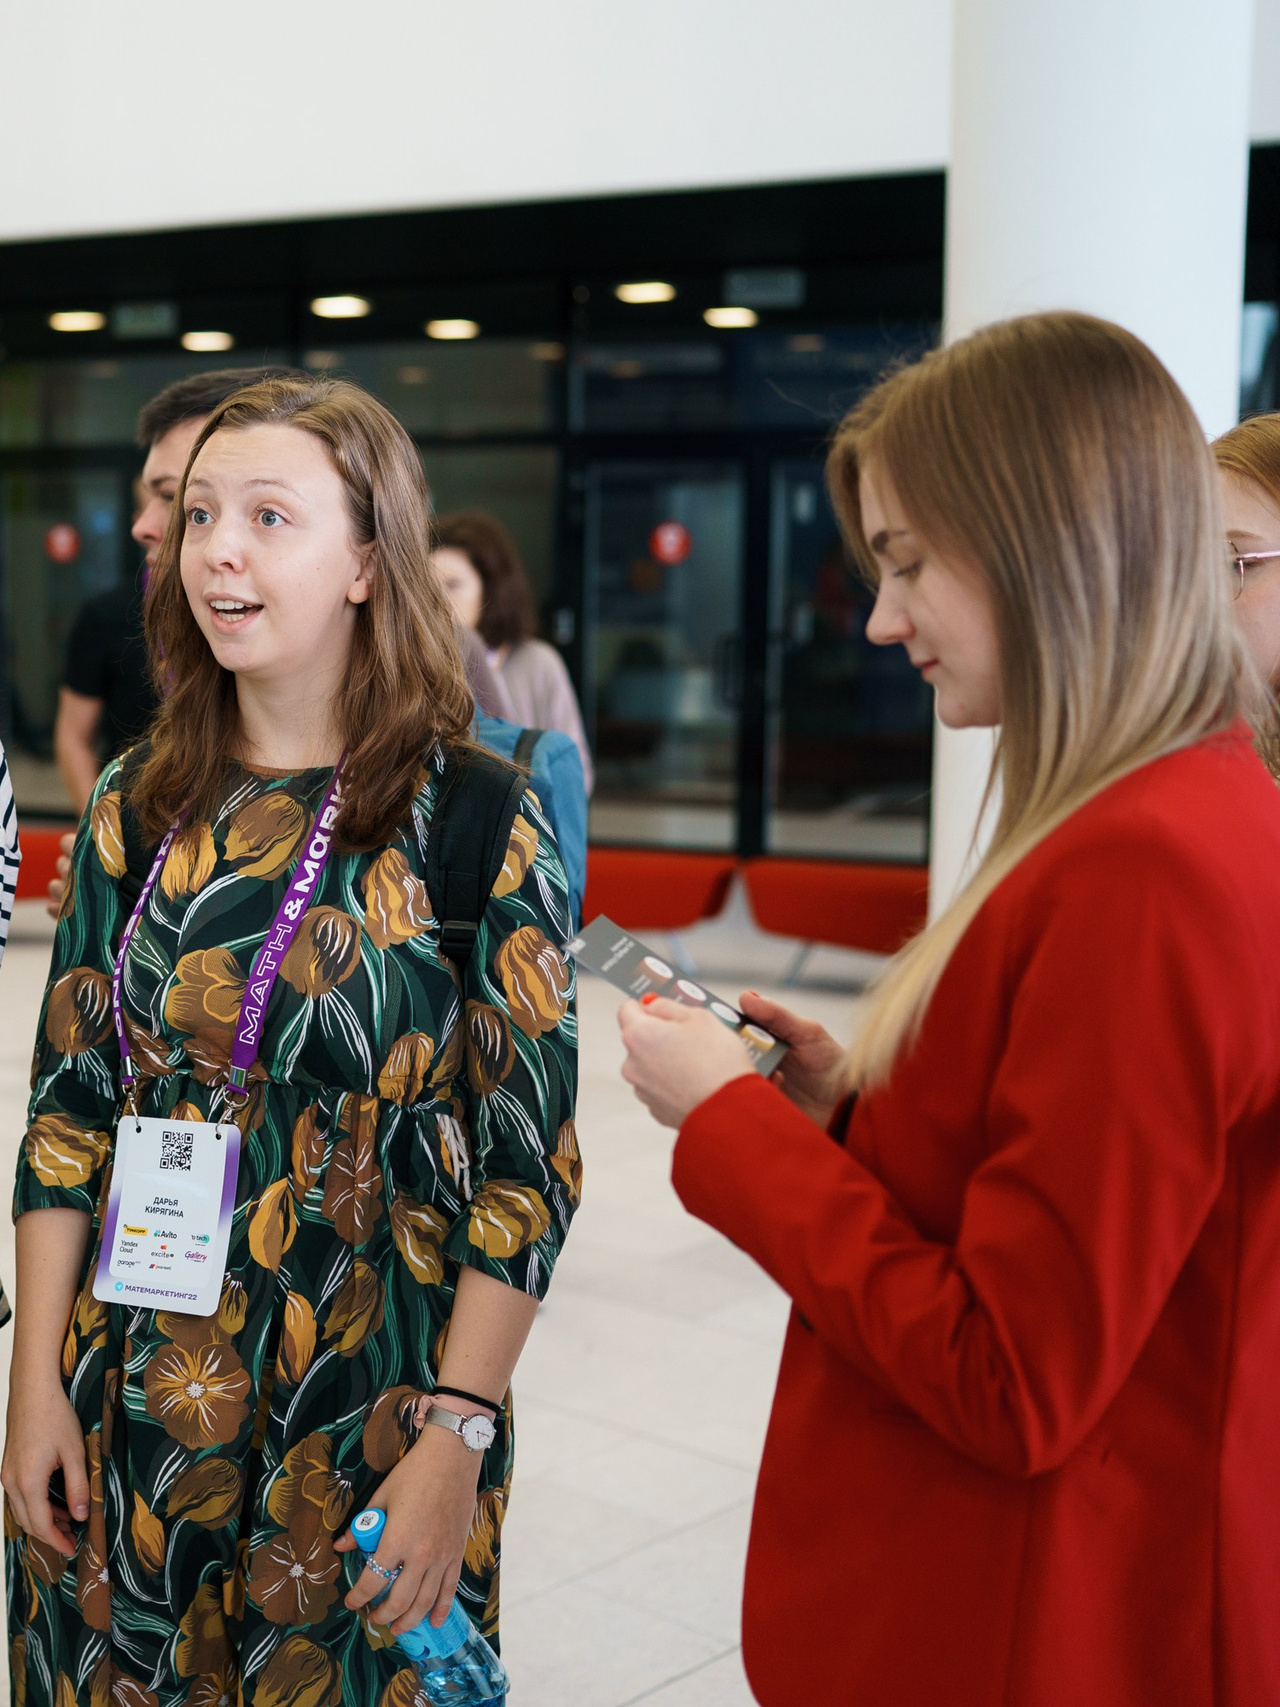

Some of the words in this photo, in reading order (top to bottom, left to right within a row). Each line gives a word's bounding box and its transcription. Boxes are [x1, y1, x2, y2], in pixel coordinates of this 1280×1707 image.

[239, 923, 293, 1045] MATH
[283, 897, 306, 921] &
[153, 1197, 179, 1207] ДАРЬЯ
[145, 1206, 184, 1218] КИРЯГИНА
[160, 1230, 178, 1240] Avito
[121, 1240, 139, 1248] Yandex
[119, 1246, 133, 1254] Cloud
[124, 1285, 198, 1301] МАТЕМАРКЕТИНГ22
